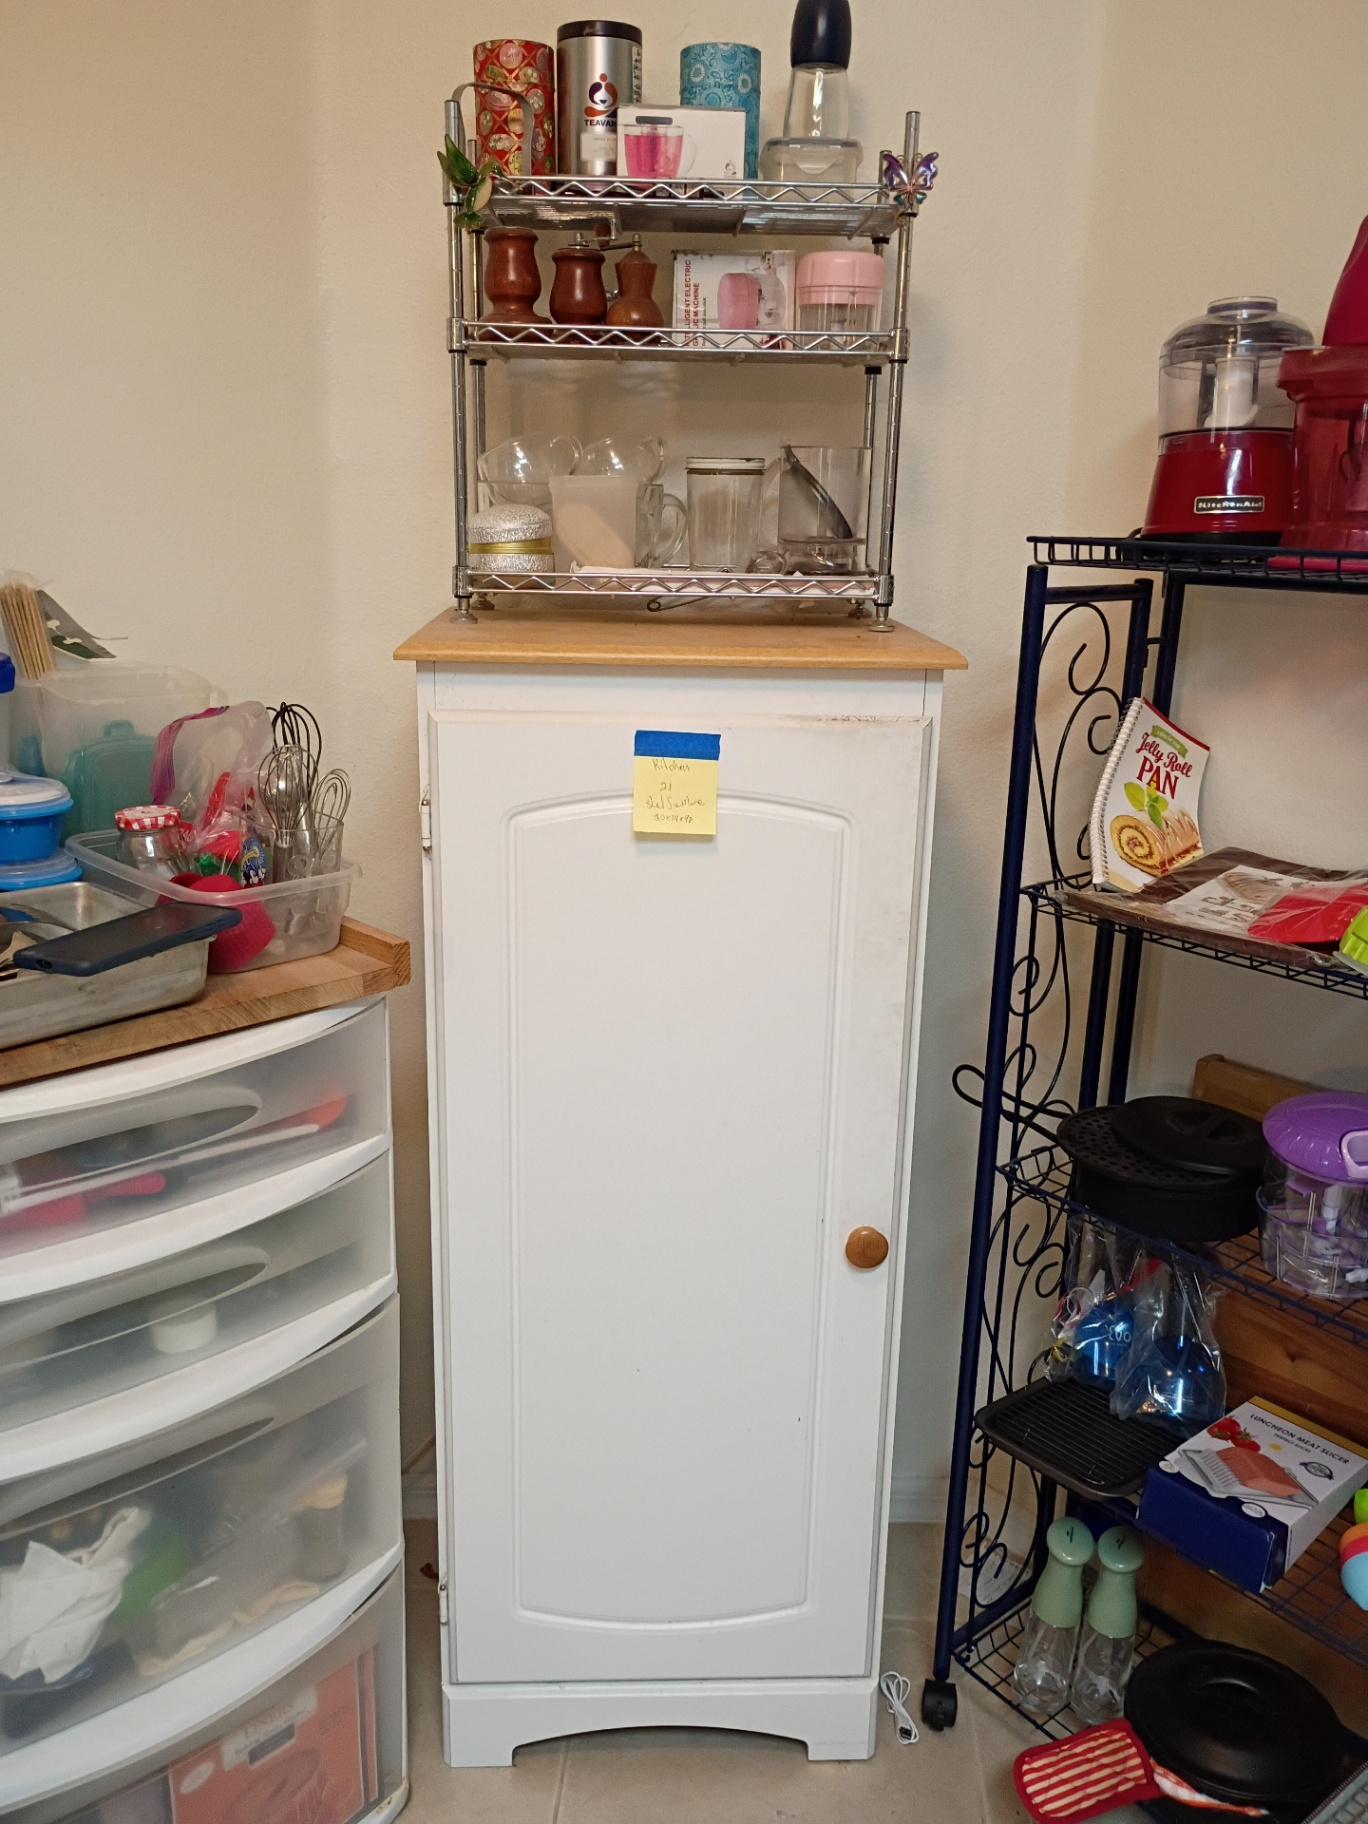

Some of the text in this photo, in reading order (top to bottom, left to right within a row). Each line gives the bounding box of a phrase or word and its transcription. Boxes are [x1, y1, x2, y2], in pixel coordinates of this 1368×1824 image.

[584, 119, 617, 127] TEAVAN
[652, 757, 690, 772] Kitchen
[1135, 732, 1165, 763] Jelly
[1163, 751, 1193, 778] Roll
[659, 781, 672, 792] 21
[1136, 755, 1179, 800] PAN
[1250, 1413, 1350, 1464] LUNCHEON MEAT SLICER
